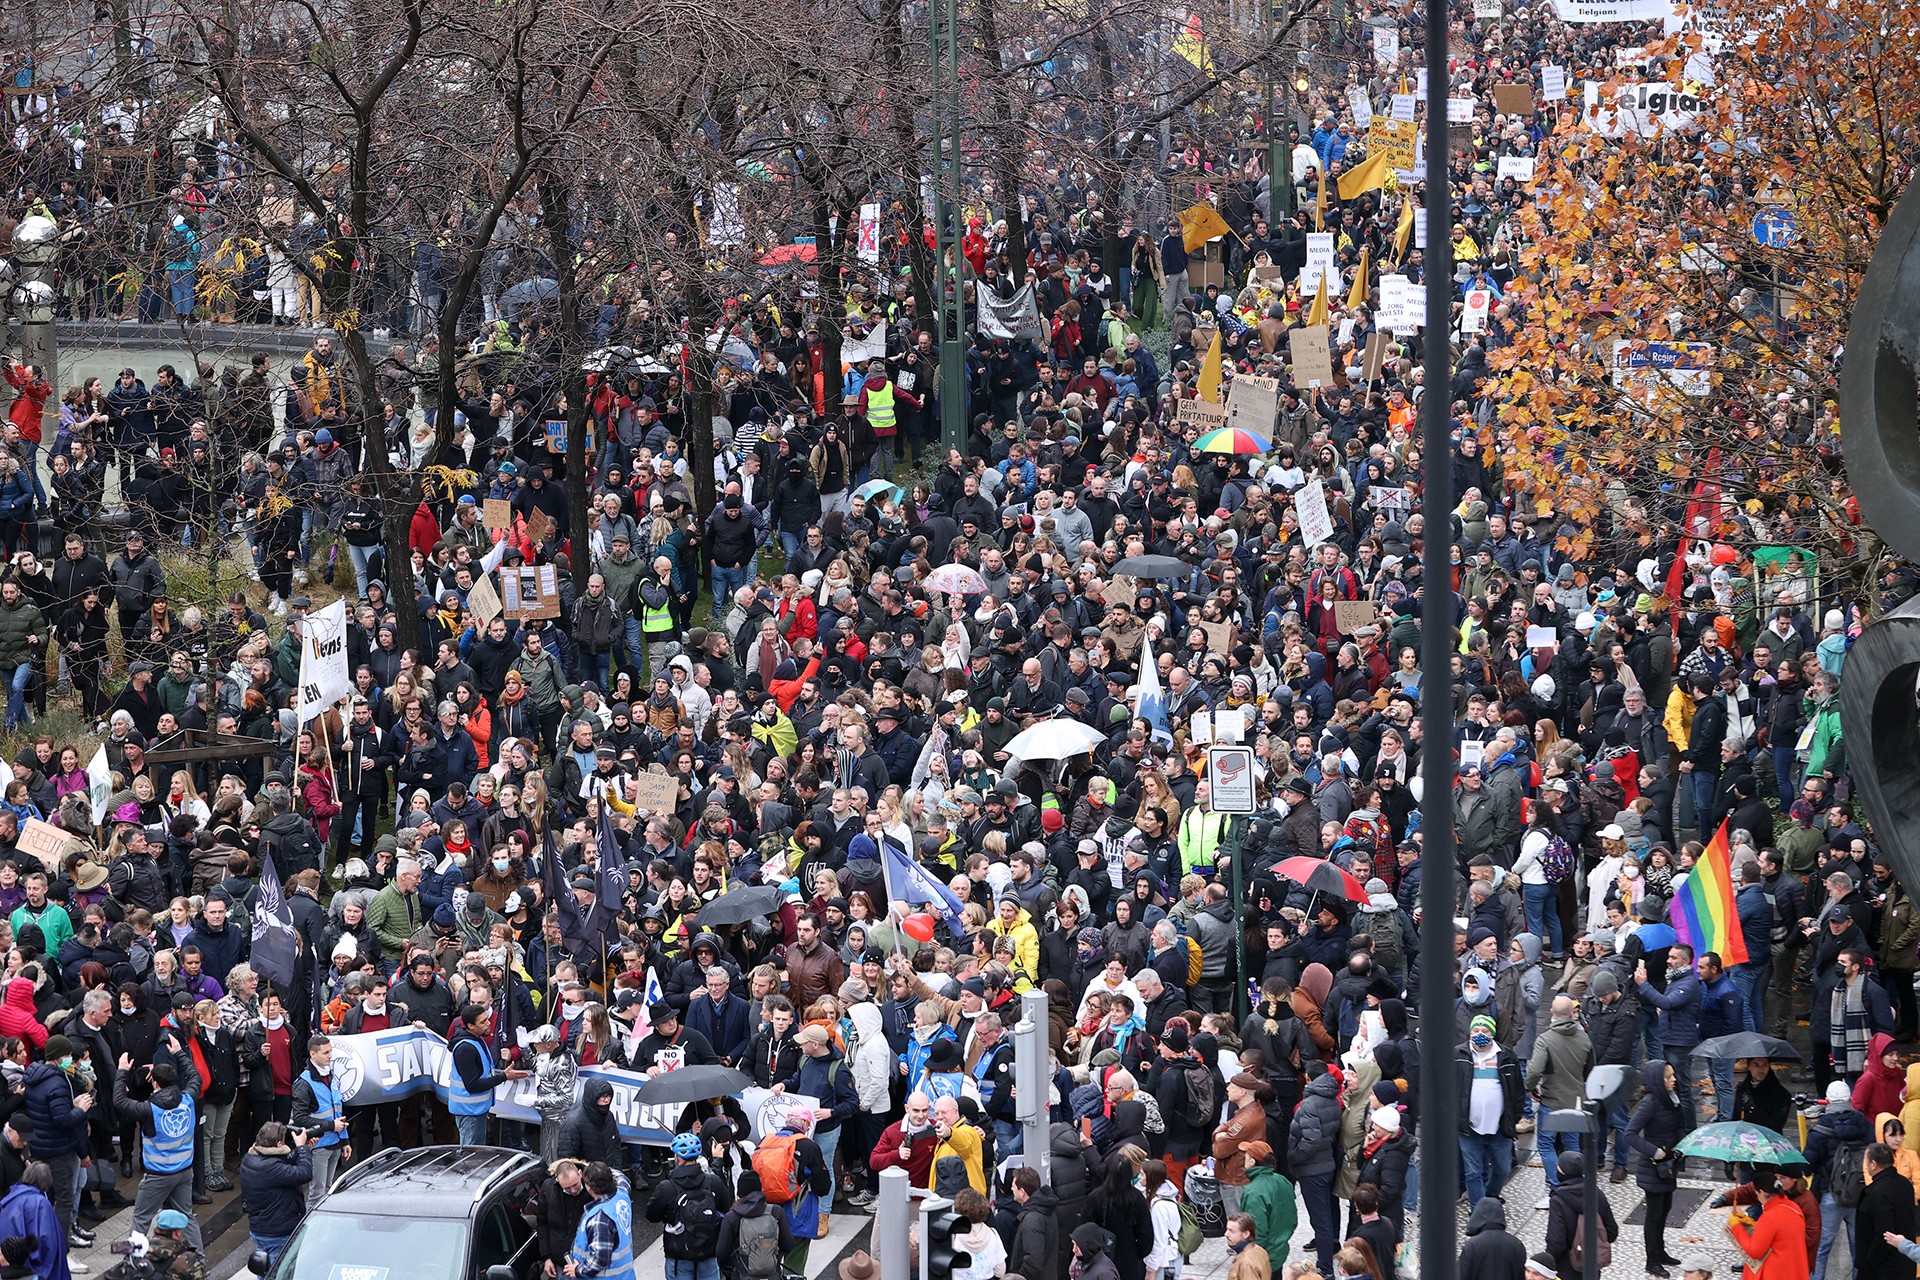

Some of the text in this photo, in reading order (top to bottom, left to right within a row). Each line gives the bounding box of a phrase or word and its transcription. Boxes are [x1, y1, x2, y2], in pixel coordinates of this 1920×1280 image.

[1252, 379, 1274, 390] MIND
[1180, 400, 1198, 410] GEEN
[664, 1051, 678, 1059] NO
[763, 1096, 786, 1109] SAMEN
[340, 1267, 379, 1277] SAMEN
